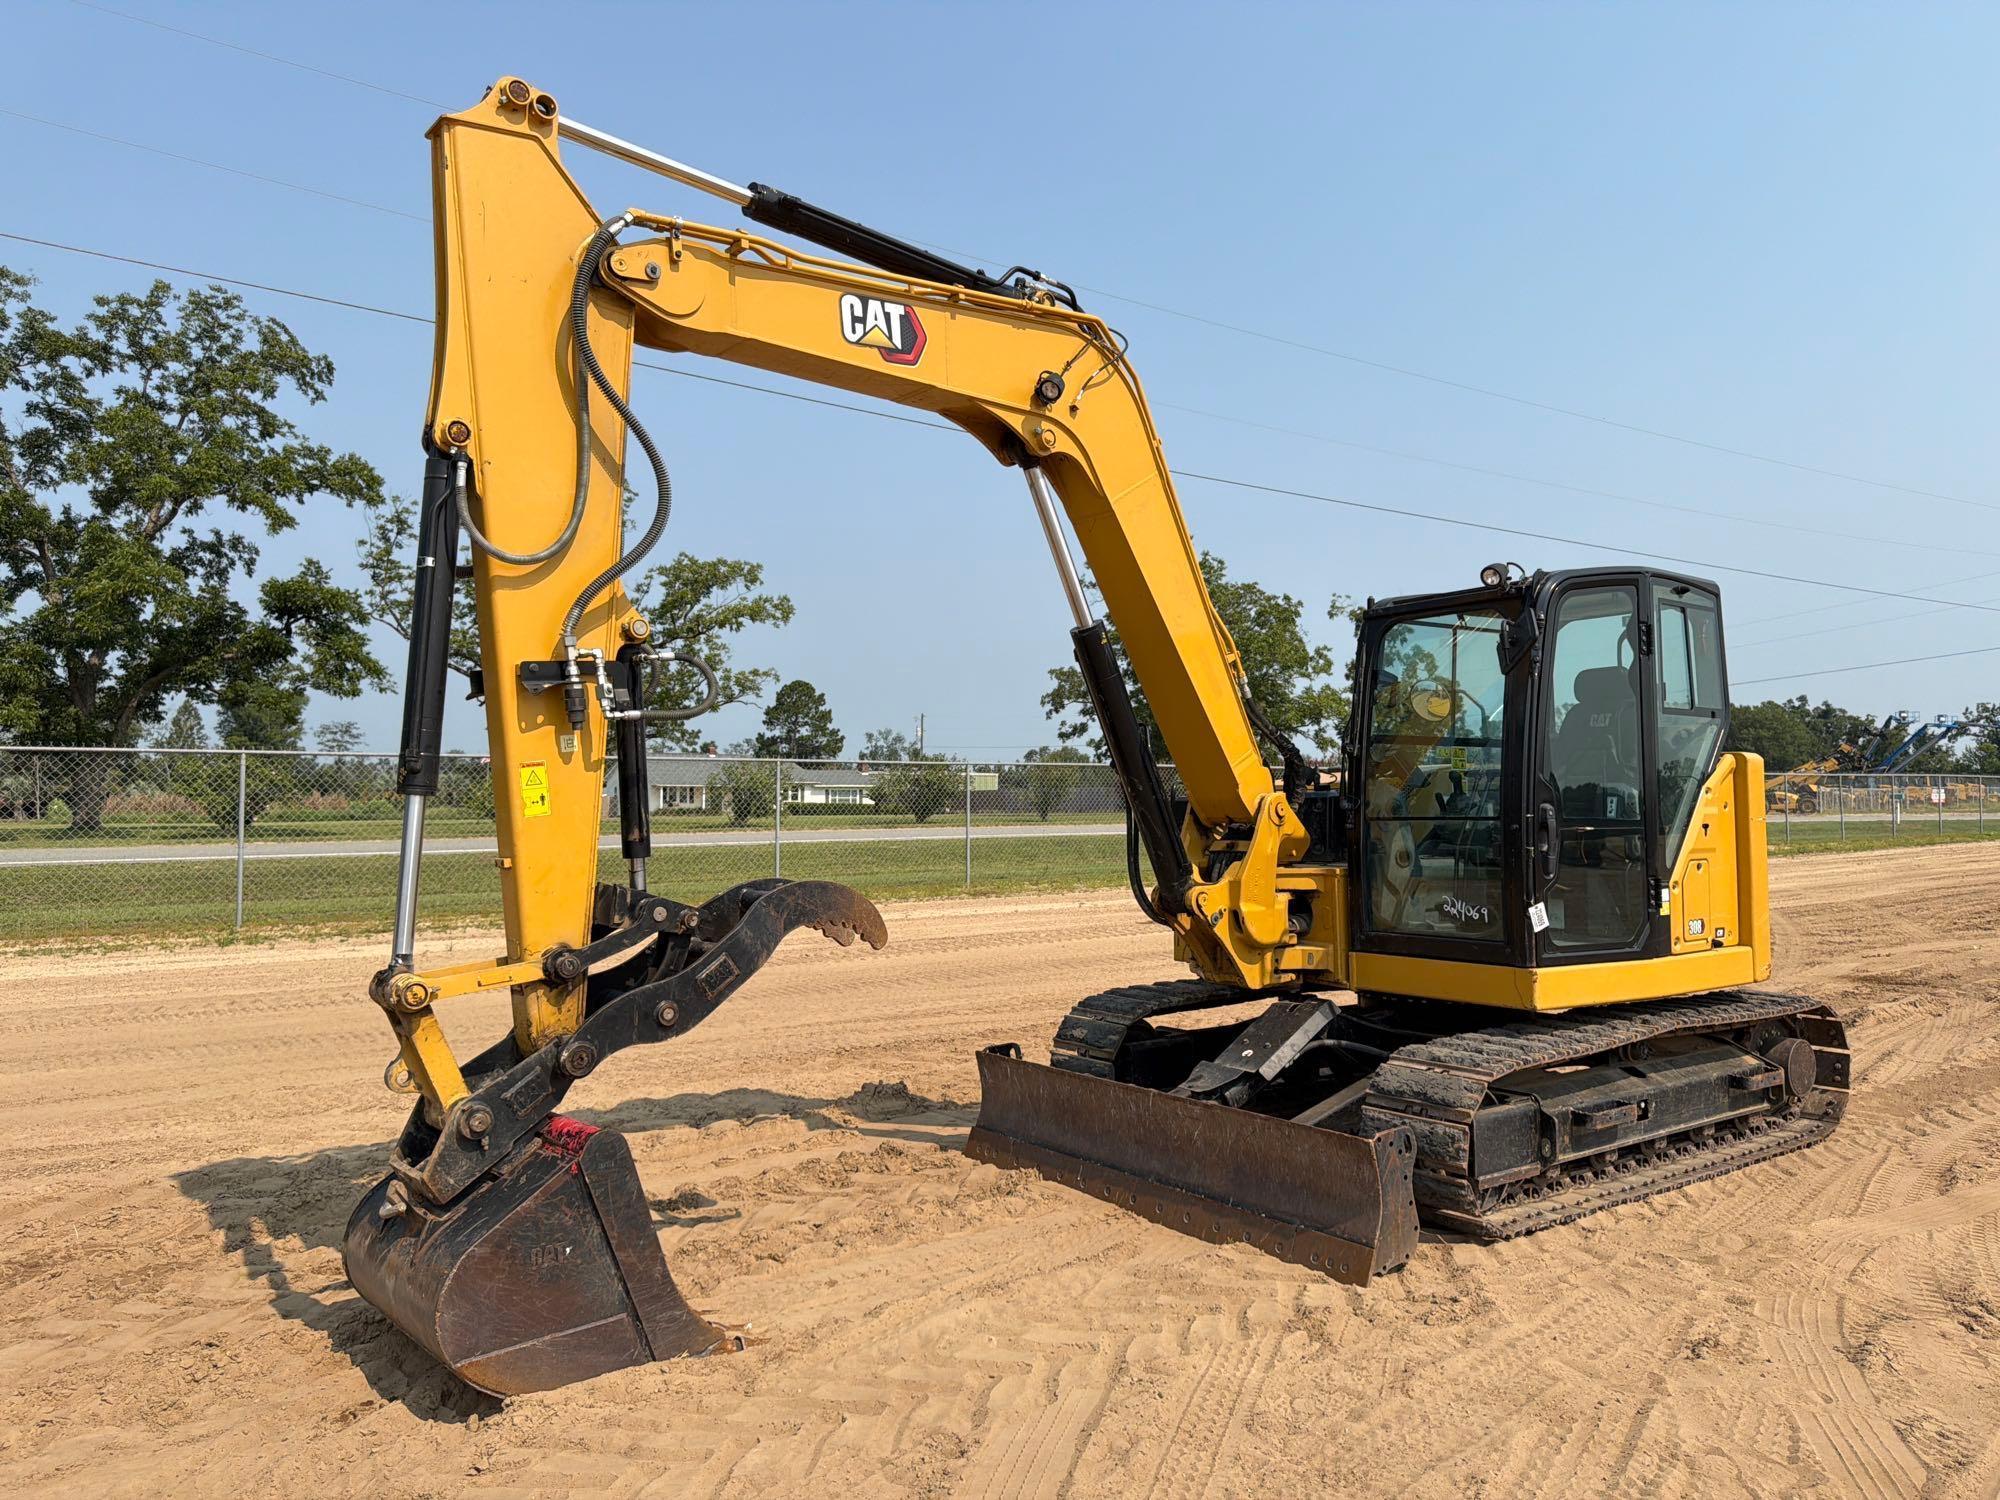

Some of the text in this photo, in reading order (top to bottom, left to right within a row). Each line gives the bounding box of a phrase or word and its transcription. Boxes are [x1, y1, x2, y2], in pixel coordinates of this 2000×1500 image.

[841, 294, 905, 350] CAT
[1590, 713, 1612, 728] CAT
[1442, 896, 1488, 923] 224069
[1688, 919, 1702, 935] 308
